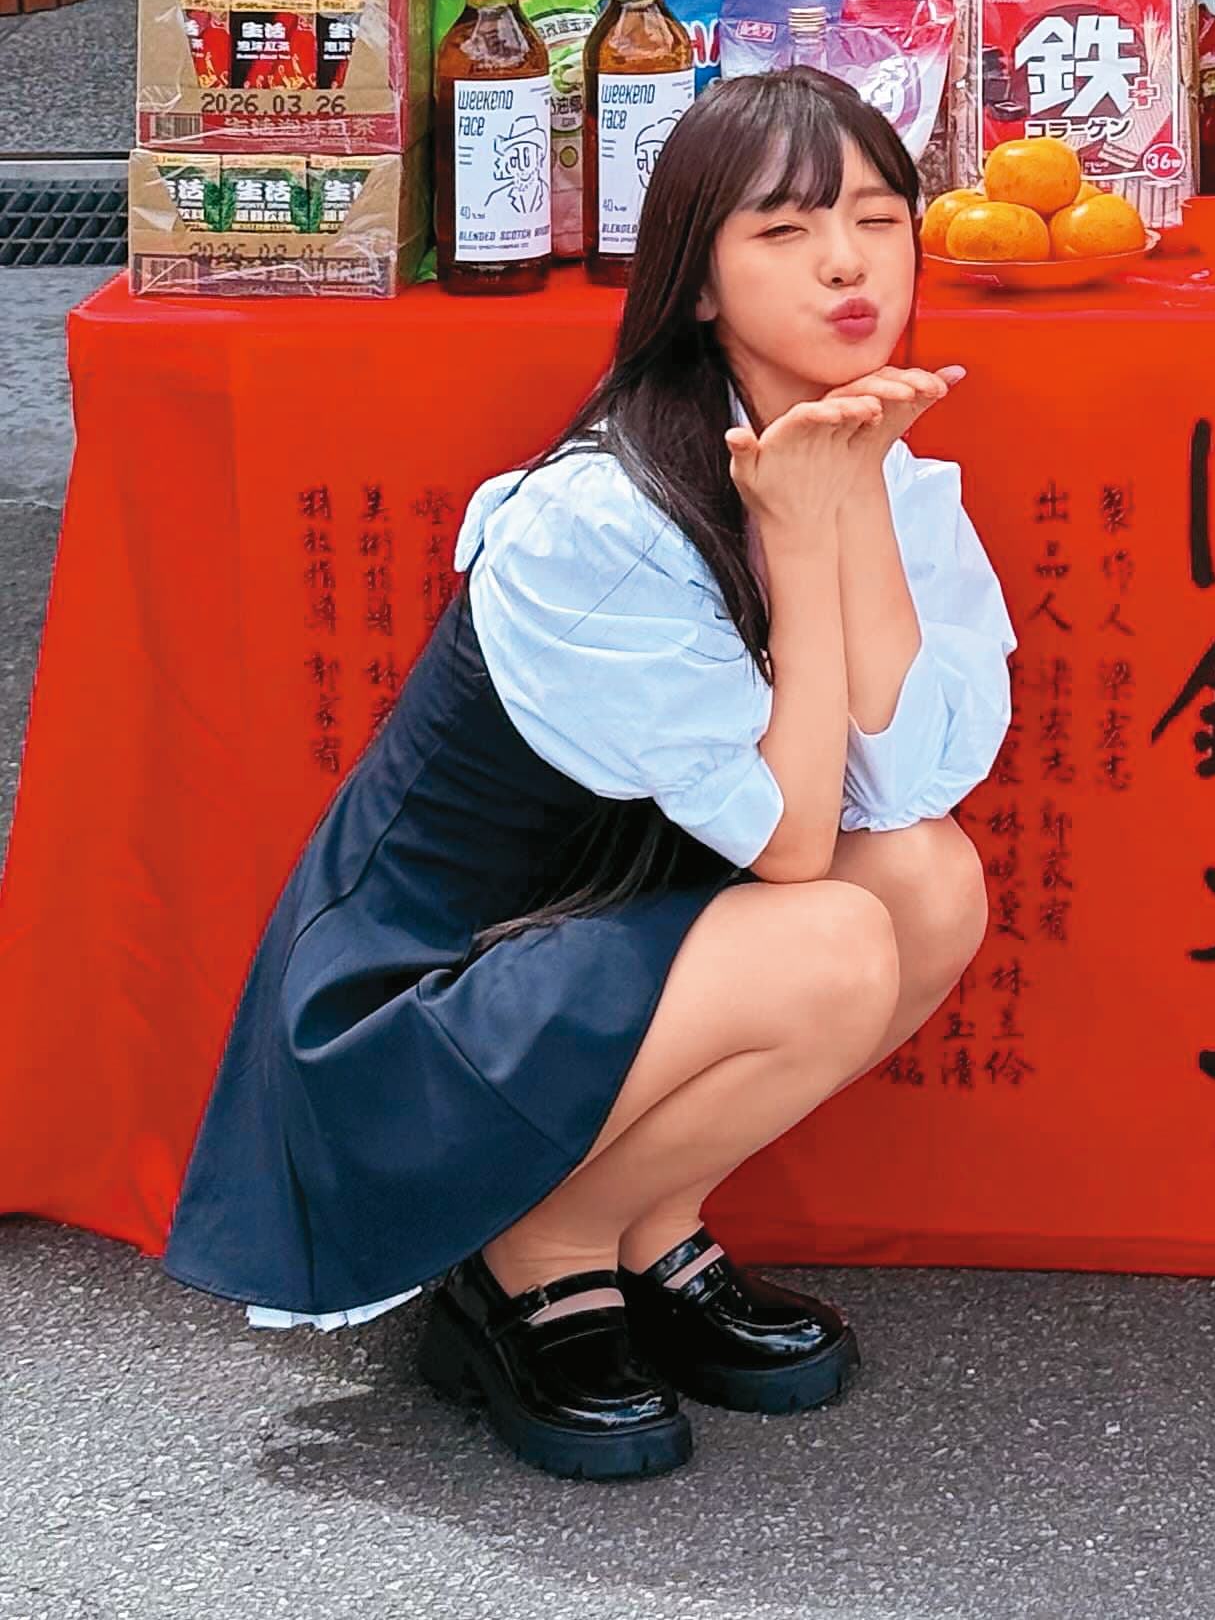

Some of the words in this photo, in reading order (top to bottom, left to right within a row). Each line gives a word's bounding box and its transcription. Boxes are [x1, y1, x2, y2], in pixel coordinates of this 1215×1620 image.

[1015, 15, 1140, 117] 鉄
[201, 95, 346, 115] 2026.03.26
[1026, 119, 1132, 140] コラーゲン
[235, 179, 291, 201] 生活
[1026, 478, 1073, 632] 出品人
